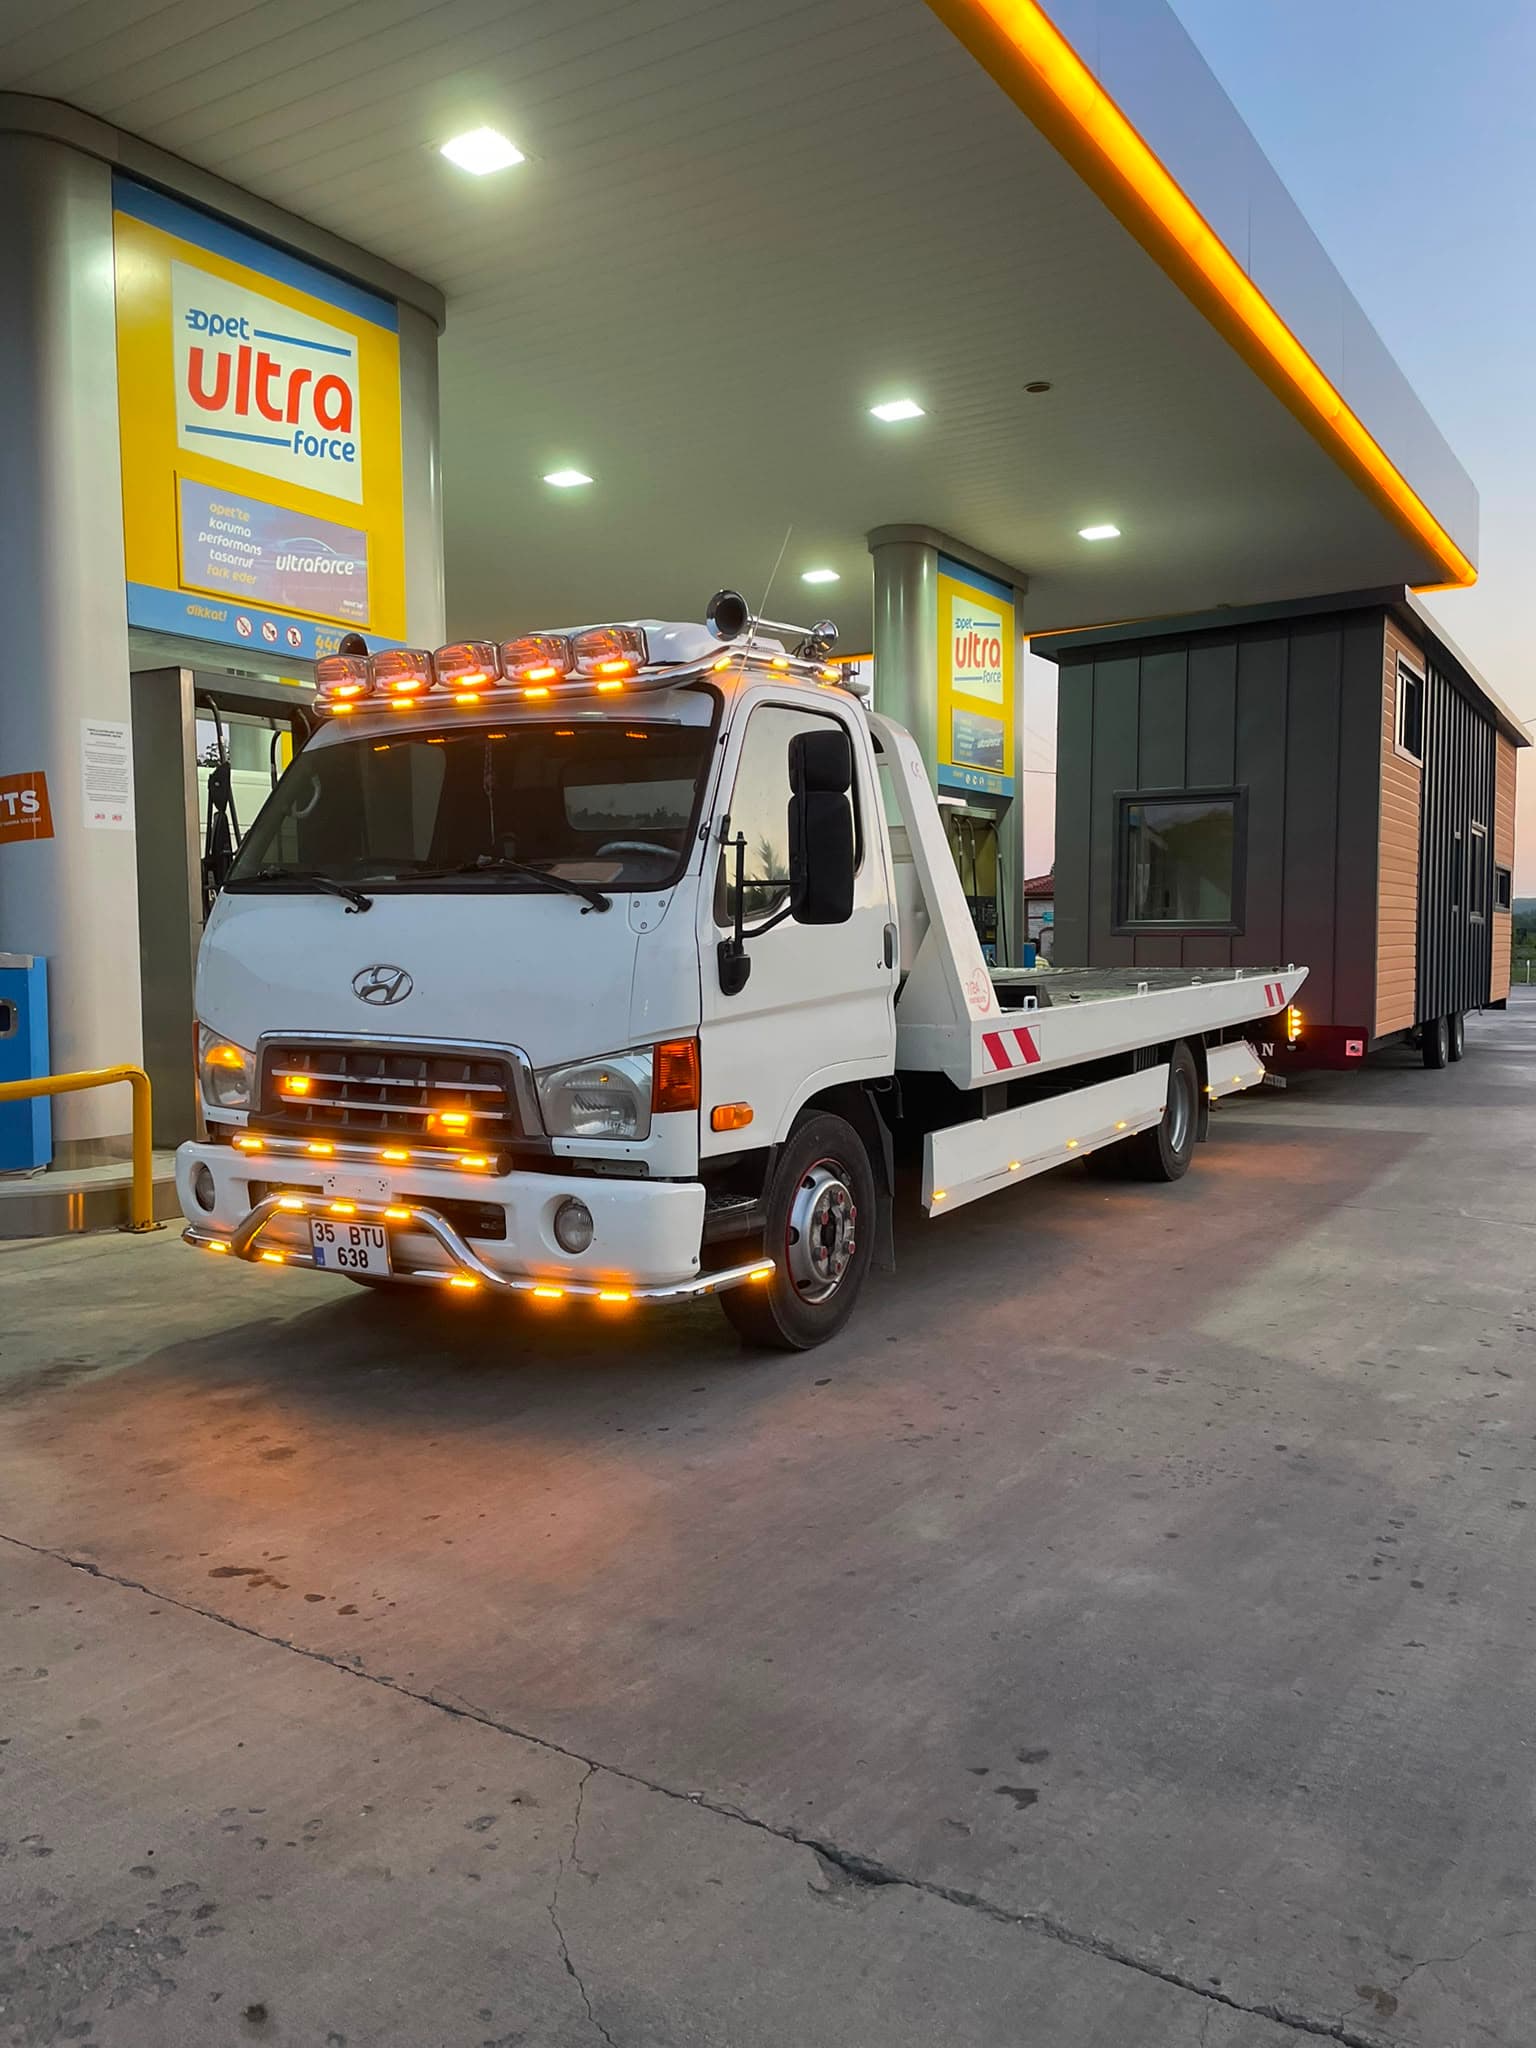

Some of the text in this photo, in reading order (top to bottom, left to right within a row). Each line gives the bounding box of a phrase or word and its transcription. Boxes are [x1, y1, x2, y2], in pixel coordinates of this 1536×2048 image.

[185, 308, 250, 341] opet
[187, 344, 353, 434] ultra
[294, 430, 355, 463] force
[208, 517, 252, 538] koruma
[199, 531, 263, 556] performans
[209, 548, 255, 569] tasarruf
[276, 553, 354, 576] ultraforce
[955, 631, 1001, 669] ultra
[0, 790, 40, 816] TS
[314, 1222, 384, 1248] 35 BTU
[337, 1246, 369, 1269] 638
